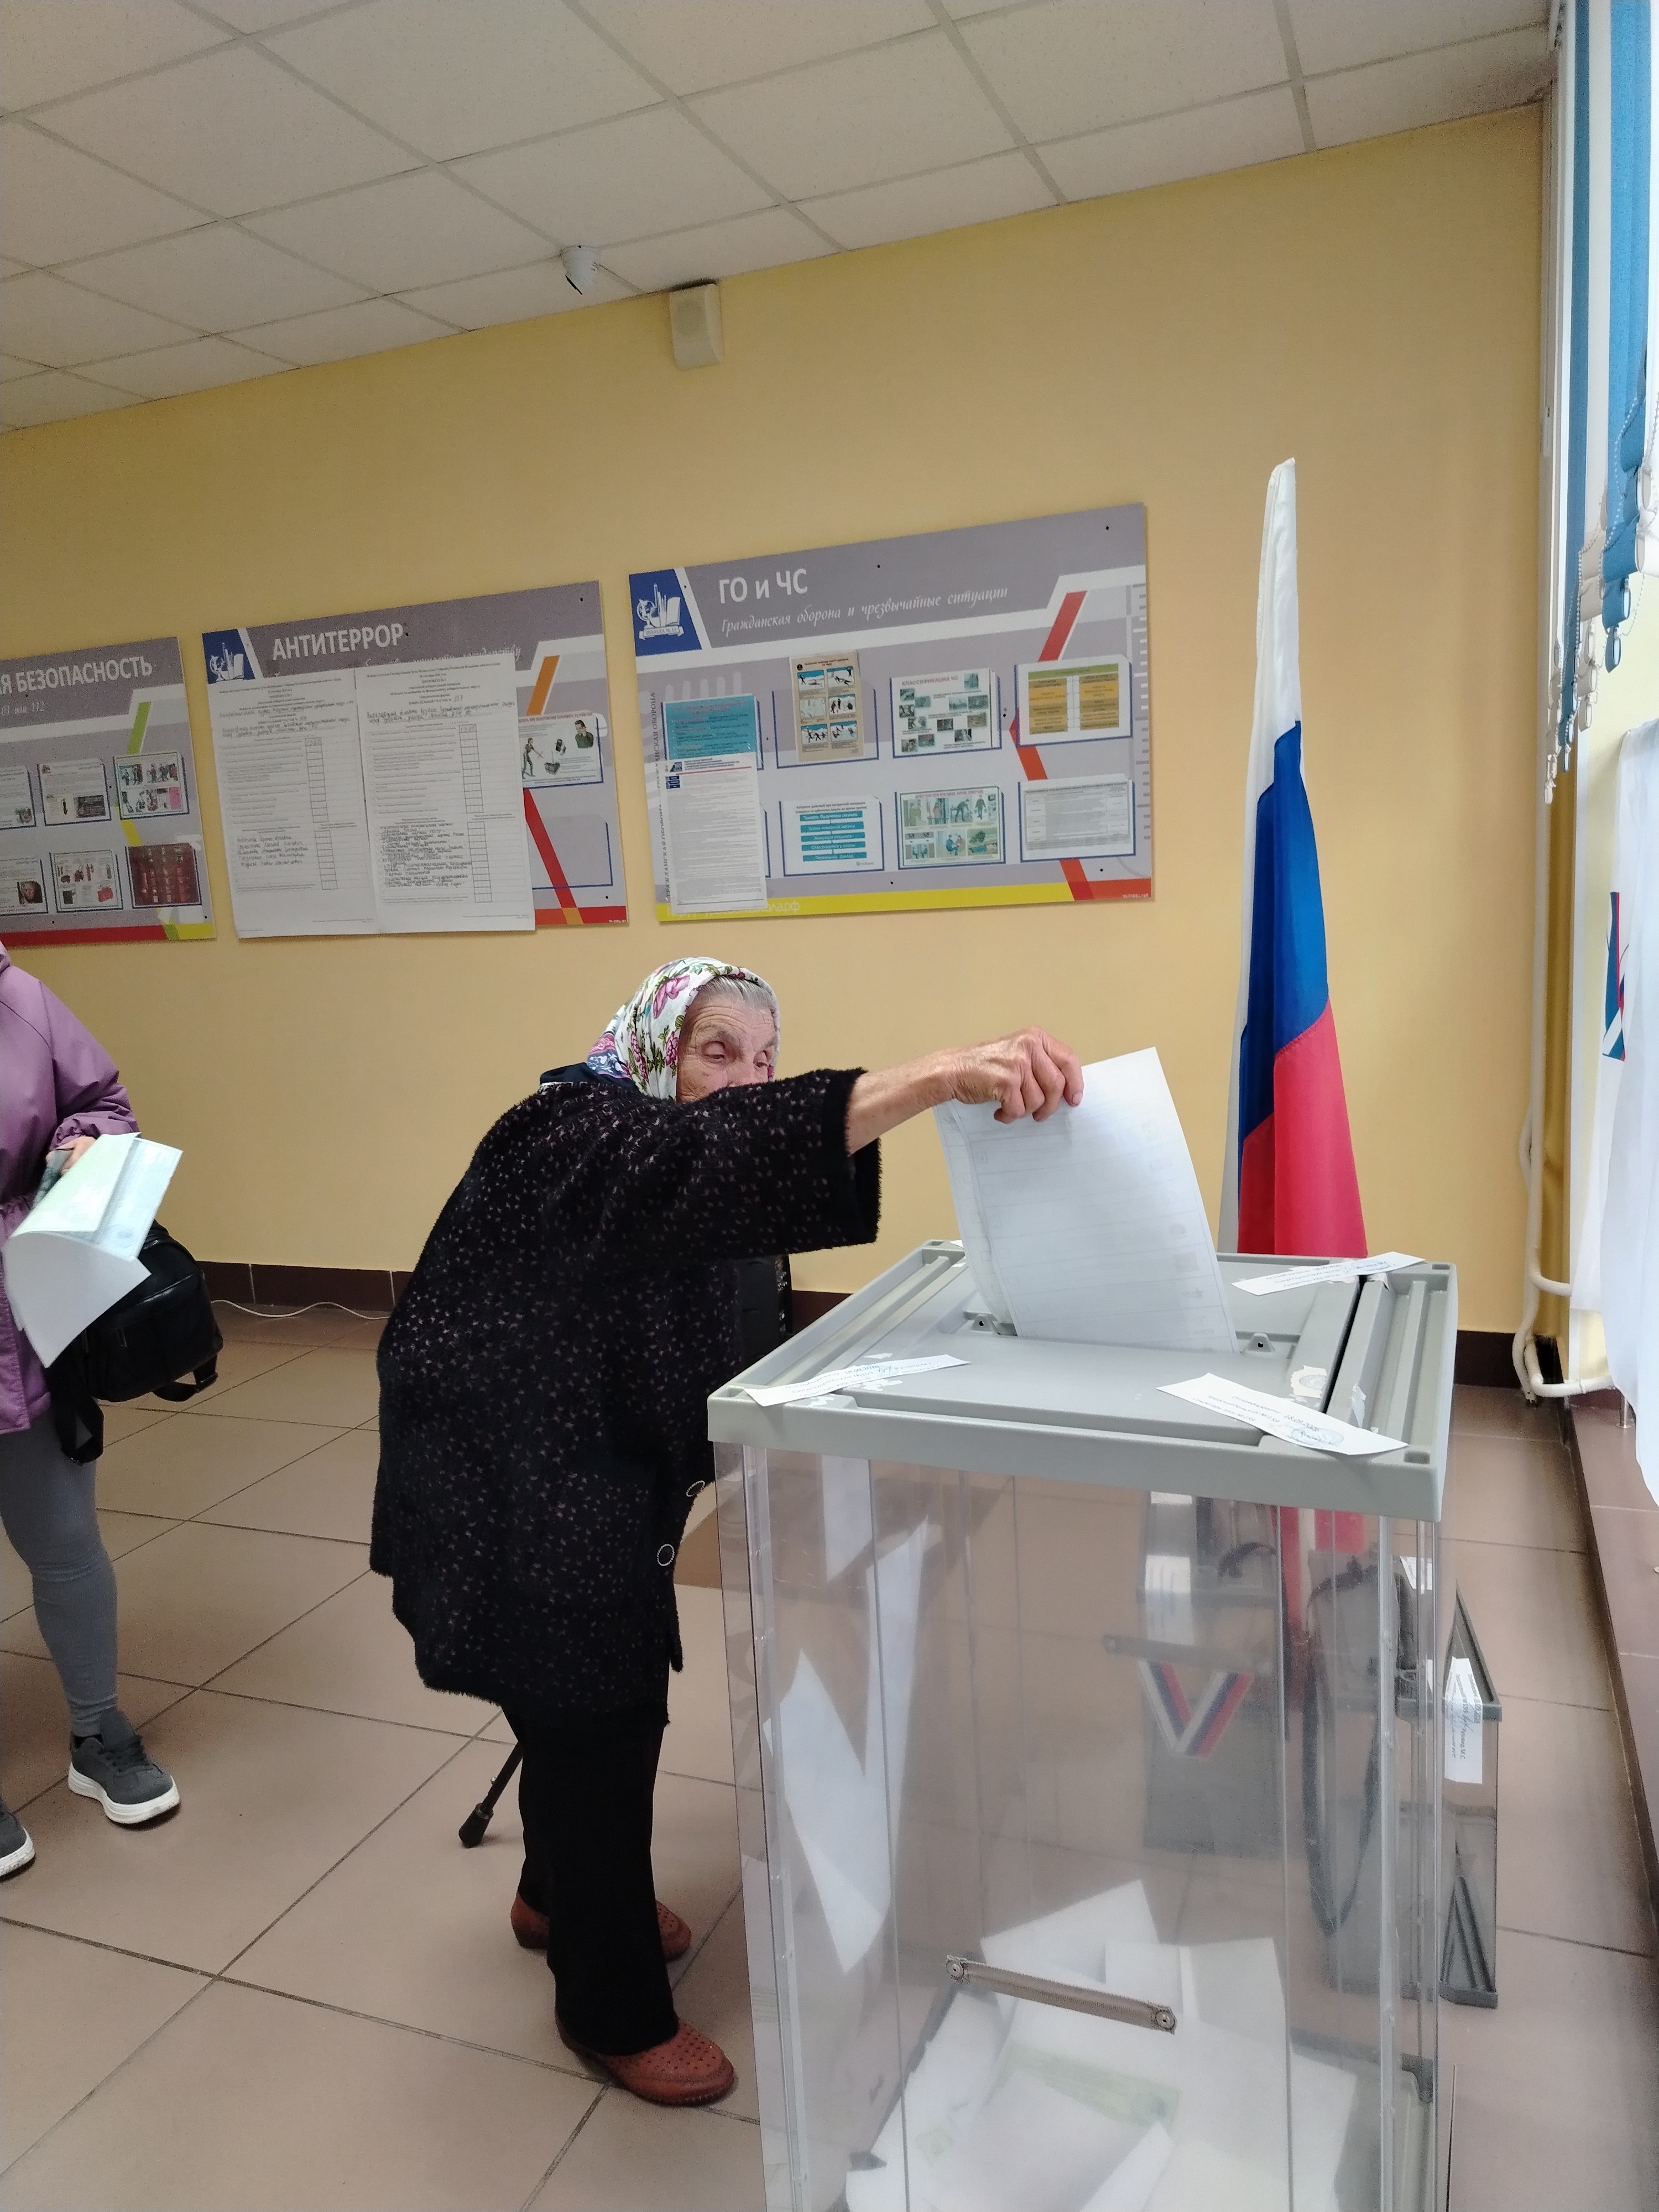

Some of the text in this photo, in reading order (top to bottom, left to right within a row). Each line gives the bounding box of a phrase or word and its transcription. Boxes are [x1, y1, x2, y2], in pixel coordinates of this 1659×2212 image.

[719, 568, 808, 604] ГО и ЧС
[721, 587, 1009, 638] Гражданская оборона и чрезвычайные ситуации
[273, 623, 404, 661] АНТИТЕРРОР
[15, 656, 153, 692] БЕЗОПАСНОСТЬ
[650, 692, 658, 730] ОБОРОНА
